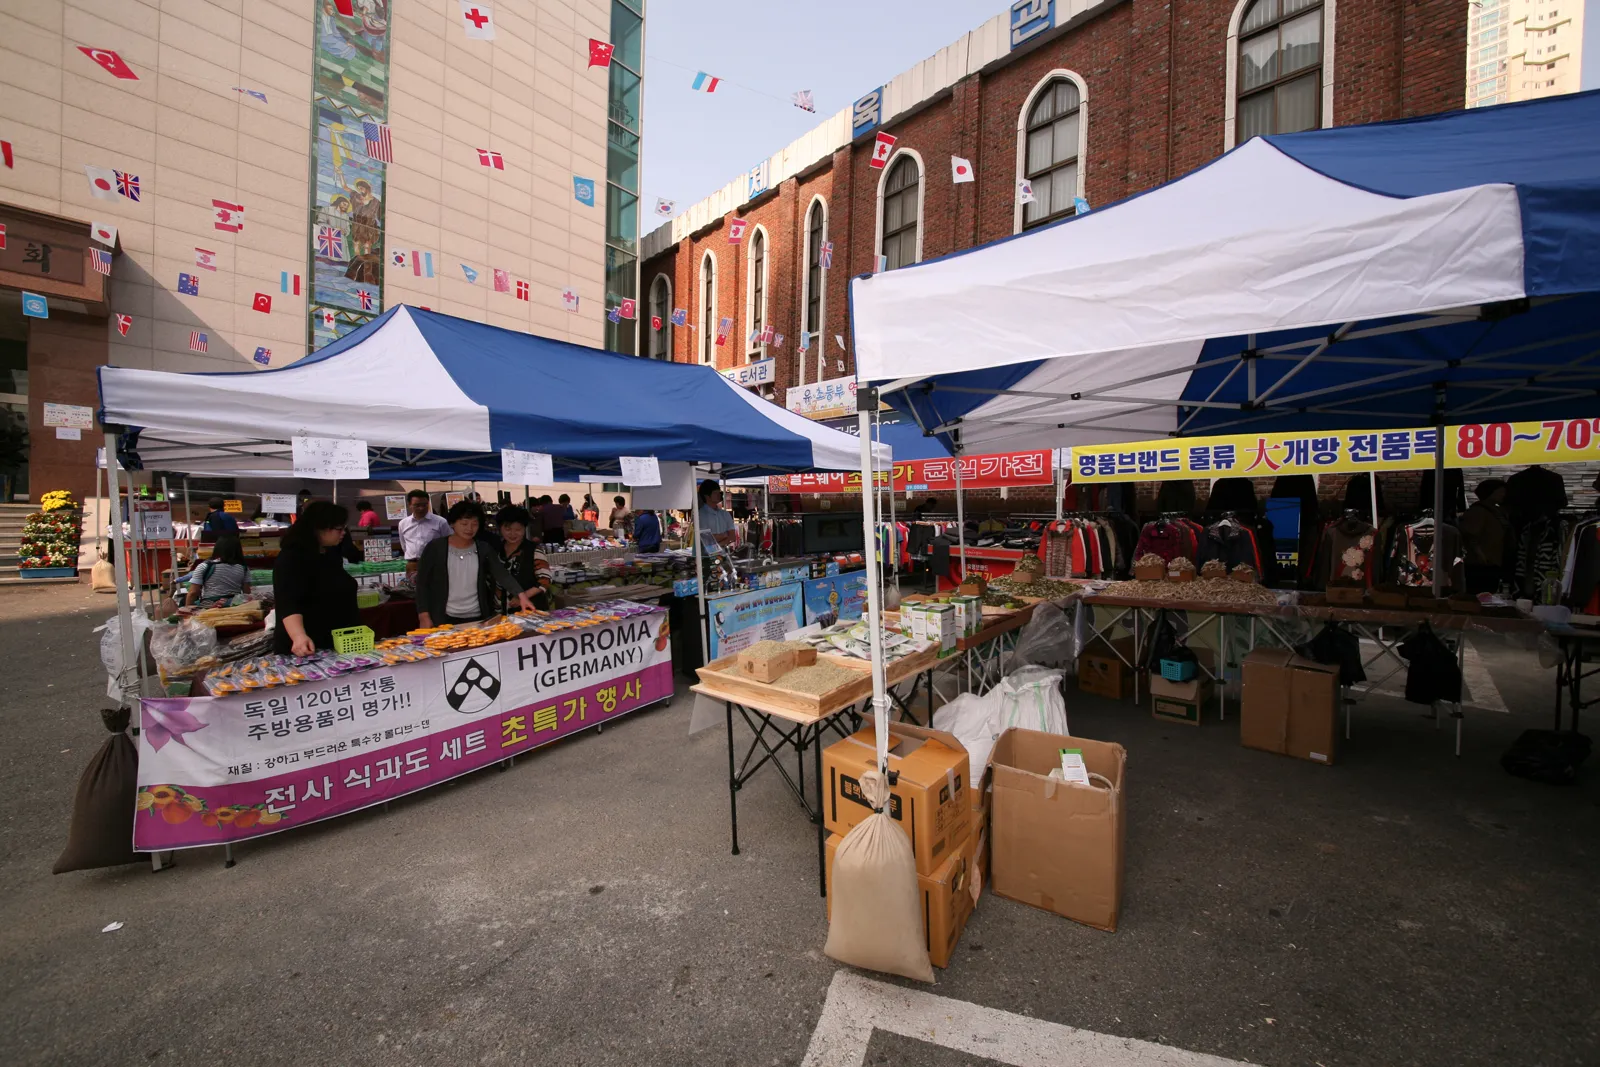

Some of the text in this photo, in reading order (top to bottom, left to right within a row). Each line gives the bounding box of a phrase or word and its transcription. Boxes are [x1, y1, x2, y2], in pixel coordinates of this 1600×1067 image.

[853, 92, 879, 128] 육
[22, 242, 51, 273] 회
[740, 364, 767, 383] 도서관
[1078, 449, 1181, 476] 명품브랜드
[1189, 445, 1236, 471] 물류
[517, 619, 652, 671] HYDROMA
[533, 646, 644, 693] (GERMANY)
[244, 675, 396, 719] 독일 120년 전통
[248, 692, 411, 741] 주방용품의 명가!!
[228, 763, 252, 775] 재질
[265, 752, 299, 768] 강하고
[303, 741, 347, 759] 부드러운
[351, 733, 381, 748] 특수강
[265, 677, 642, 814] 전사 식과도 세트 초특가 행사
